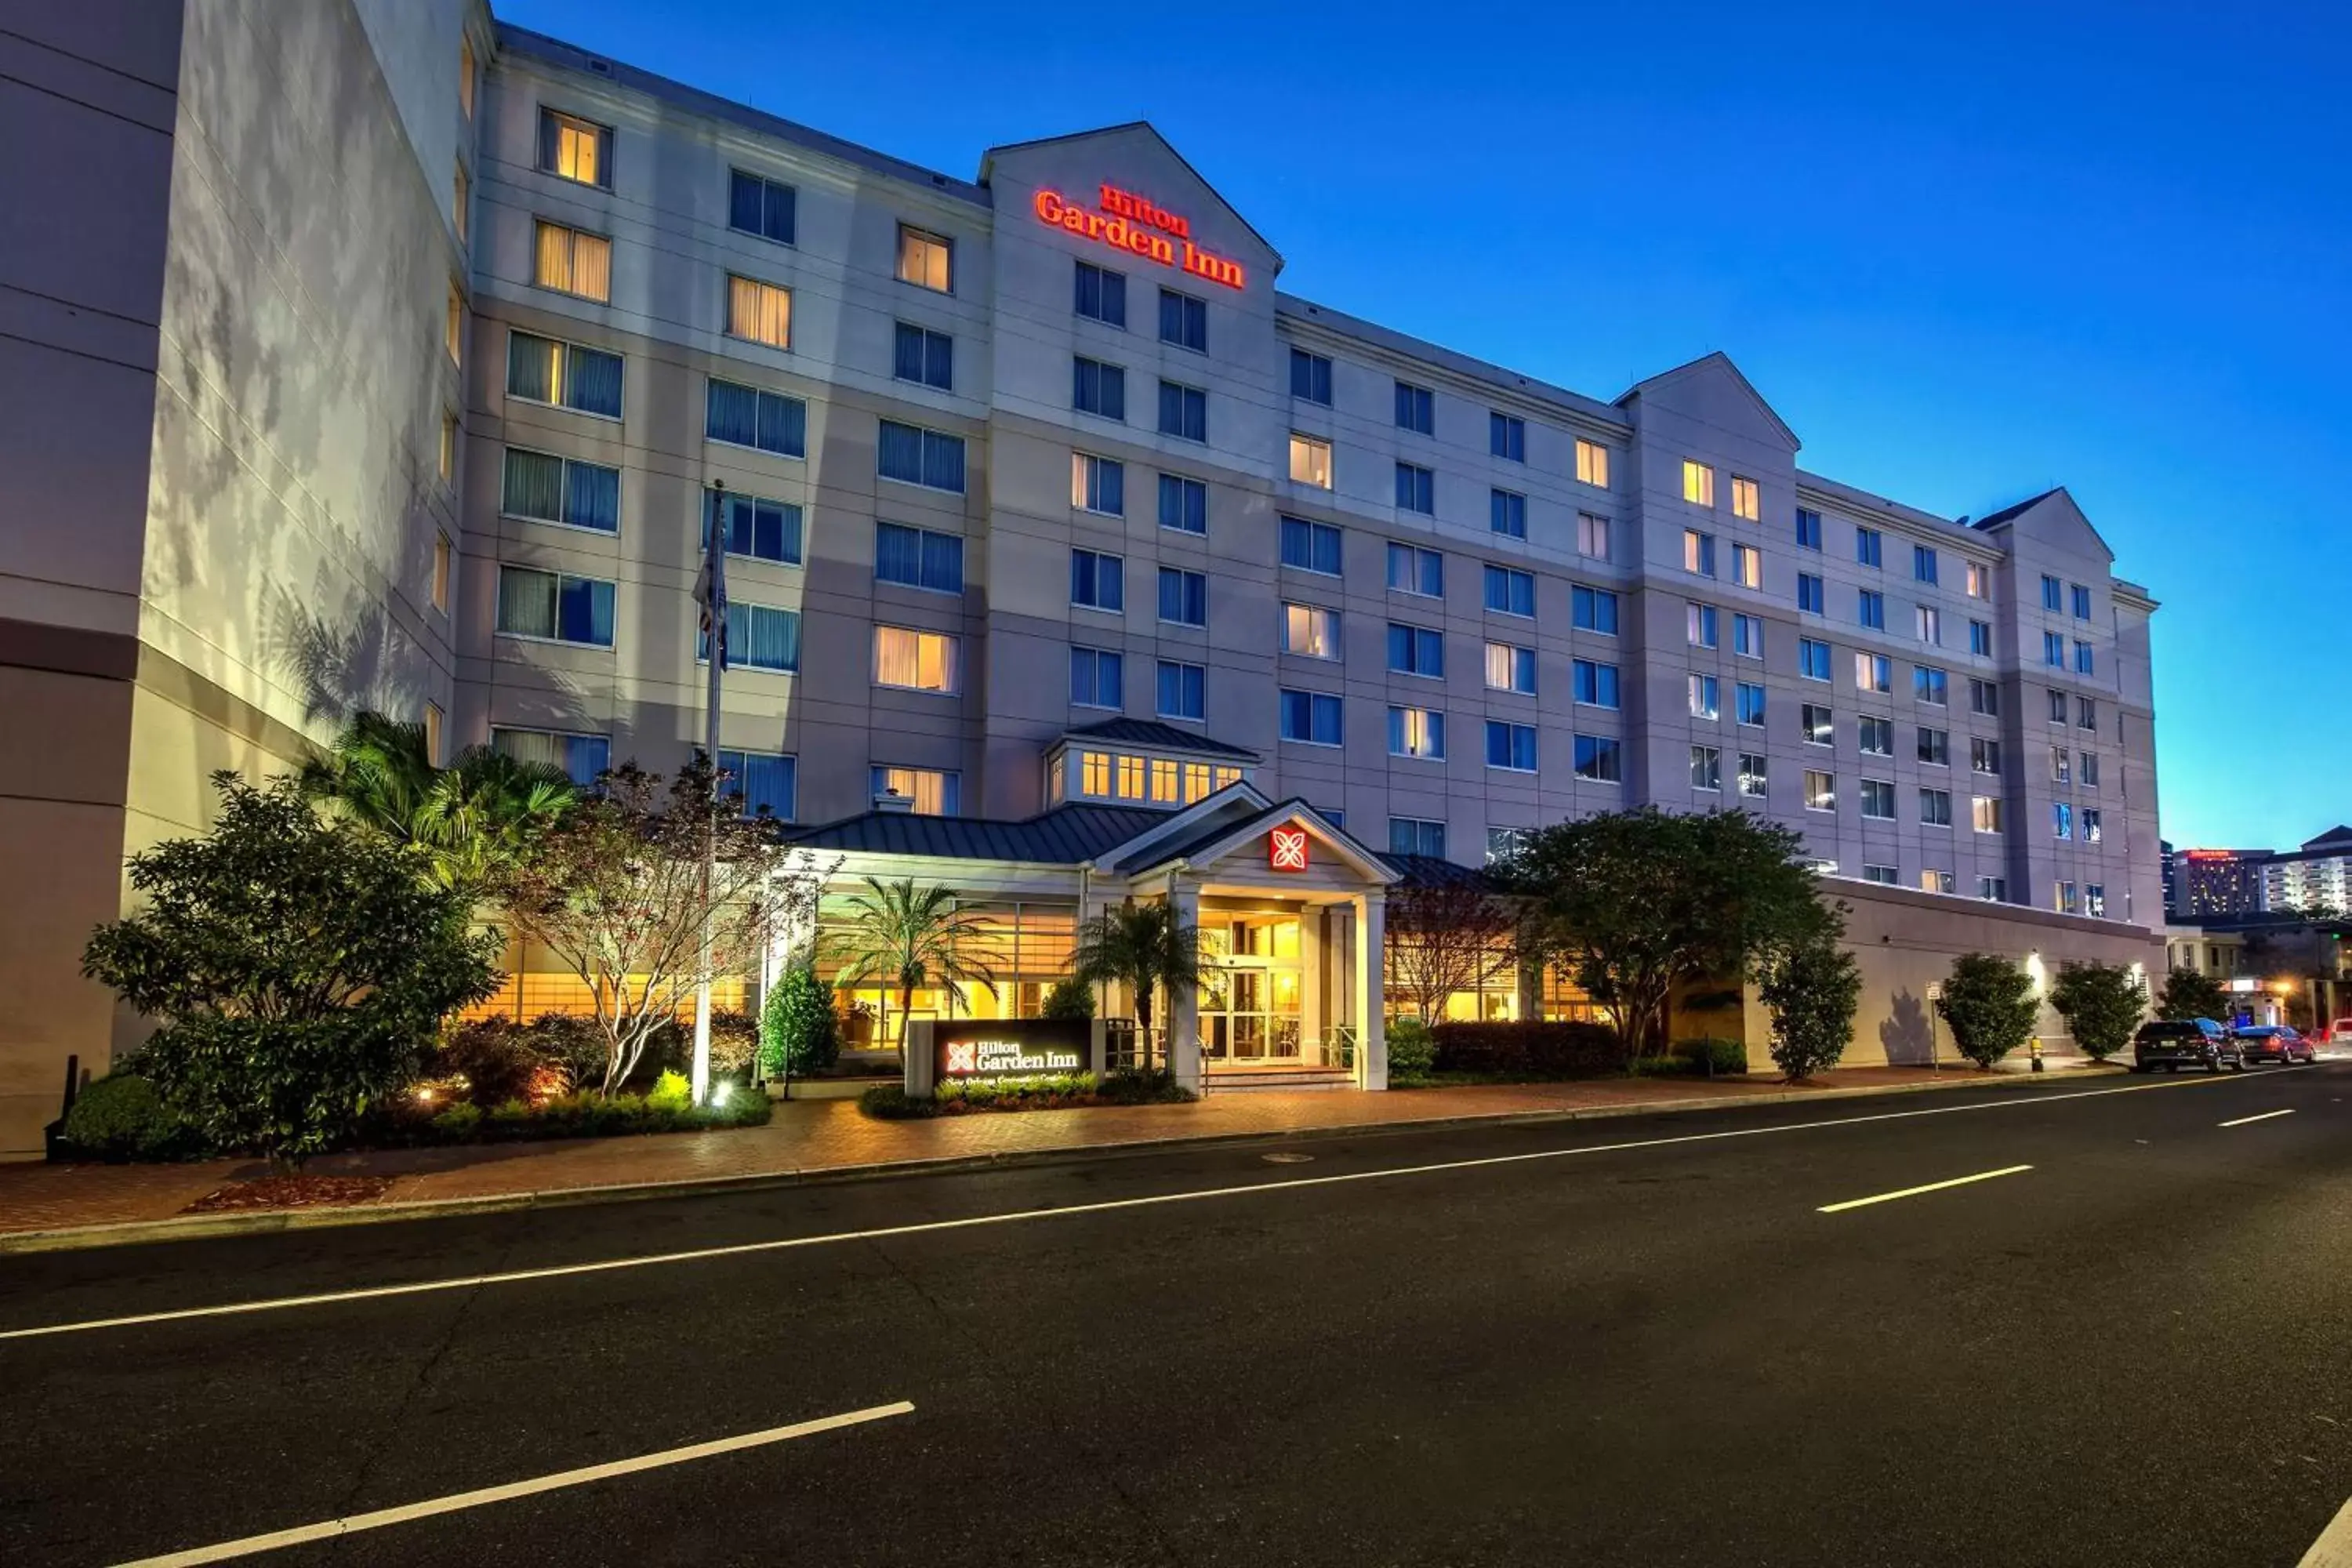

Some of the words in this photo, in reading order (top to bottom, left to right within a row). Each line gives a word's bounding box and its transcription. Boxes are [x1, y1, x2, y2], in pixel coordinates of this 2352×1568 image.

[1100, 183, 1189, 238] Hilton
[1036, 190, 1174, 266] Garden
[1181, 240, 1243, 289] Inn
[977, 1054, 1044, 1070] Garden
[1045, 1051, 1077, 1067] Inn
[978, 1041, 1020, 1054] Hilton
